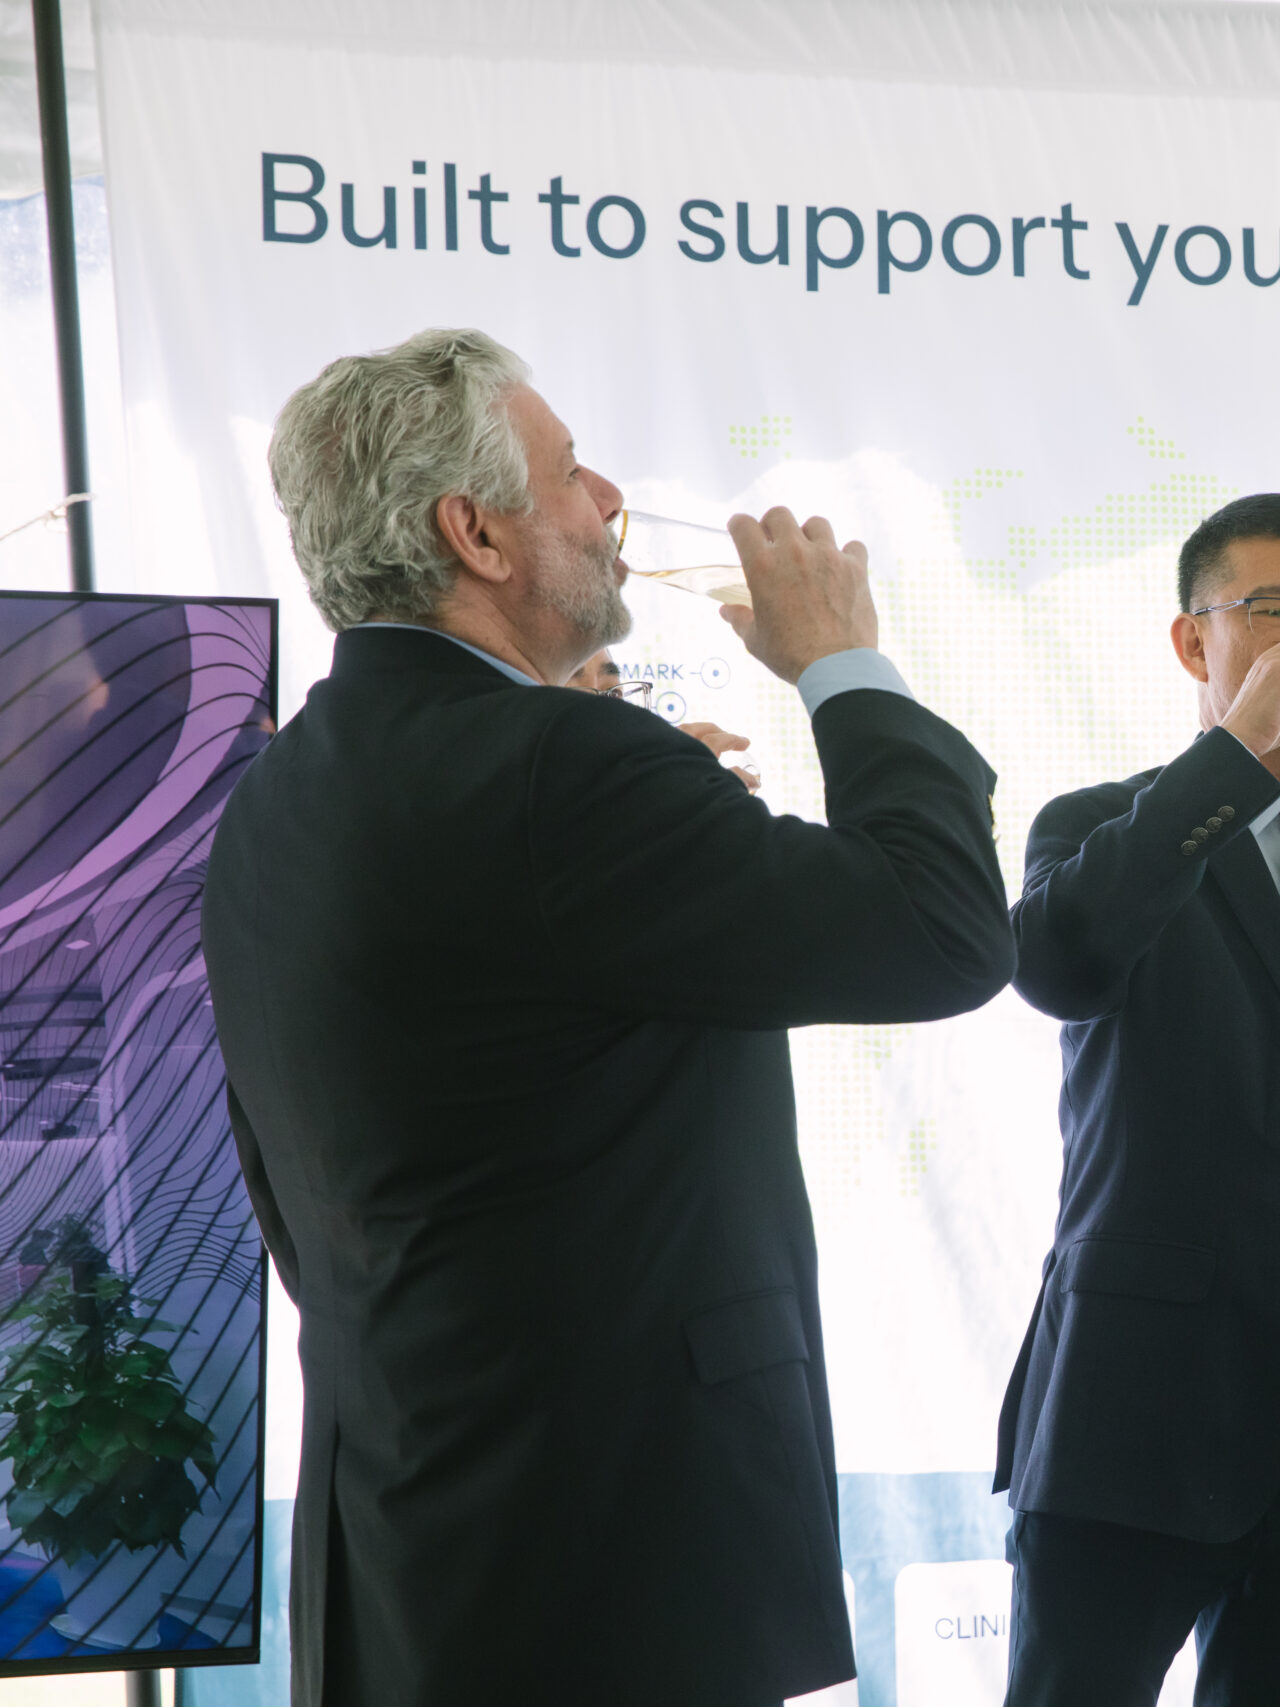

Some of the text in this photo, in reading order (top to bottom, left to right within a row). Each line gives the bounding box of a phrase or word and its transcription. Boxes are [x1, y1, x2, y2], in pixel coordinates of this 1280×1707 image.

[262, 152, 510, 255] Built
[538, 176, 646, 259] to
[678, 199, 1090, 294] support
[621, 663, 685, 680] MARK
[935, 1615, 1005, 1639] CLINI
